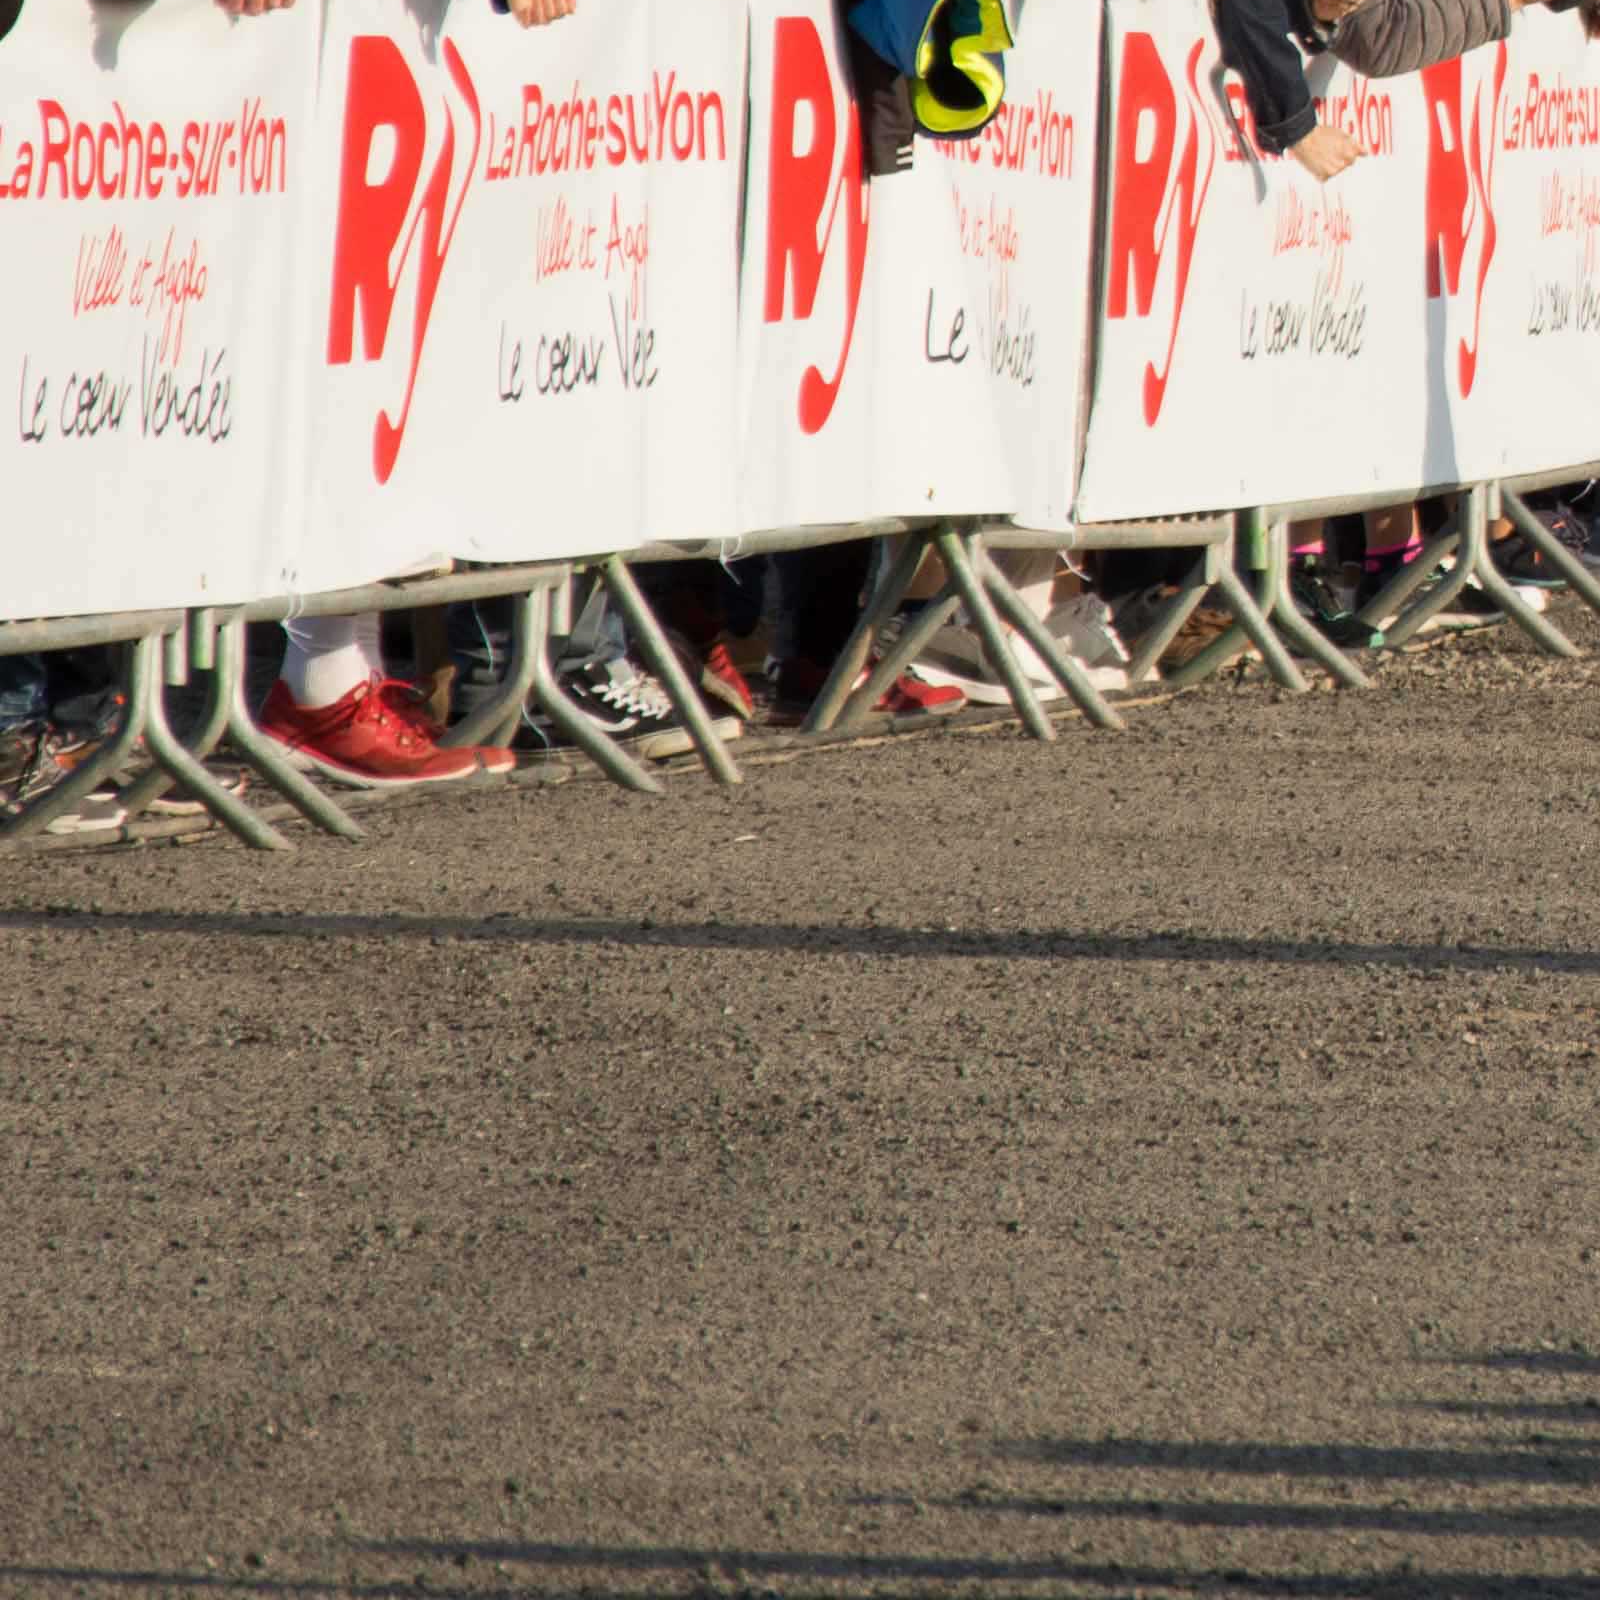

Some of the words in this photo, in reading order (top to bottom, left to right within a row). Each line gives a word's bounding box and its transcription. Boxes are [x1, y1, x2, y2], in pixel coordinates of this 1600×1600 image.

[484, 110, 515, 181] La
[499, 318, 524, 402] Le
[926, 287, 969, 364] Le
[19, 351, 48, 443] Le
[142, 329, 231, 443] Vendée
